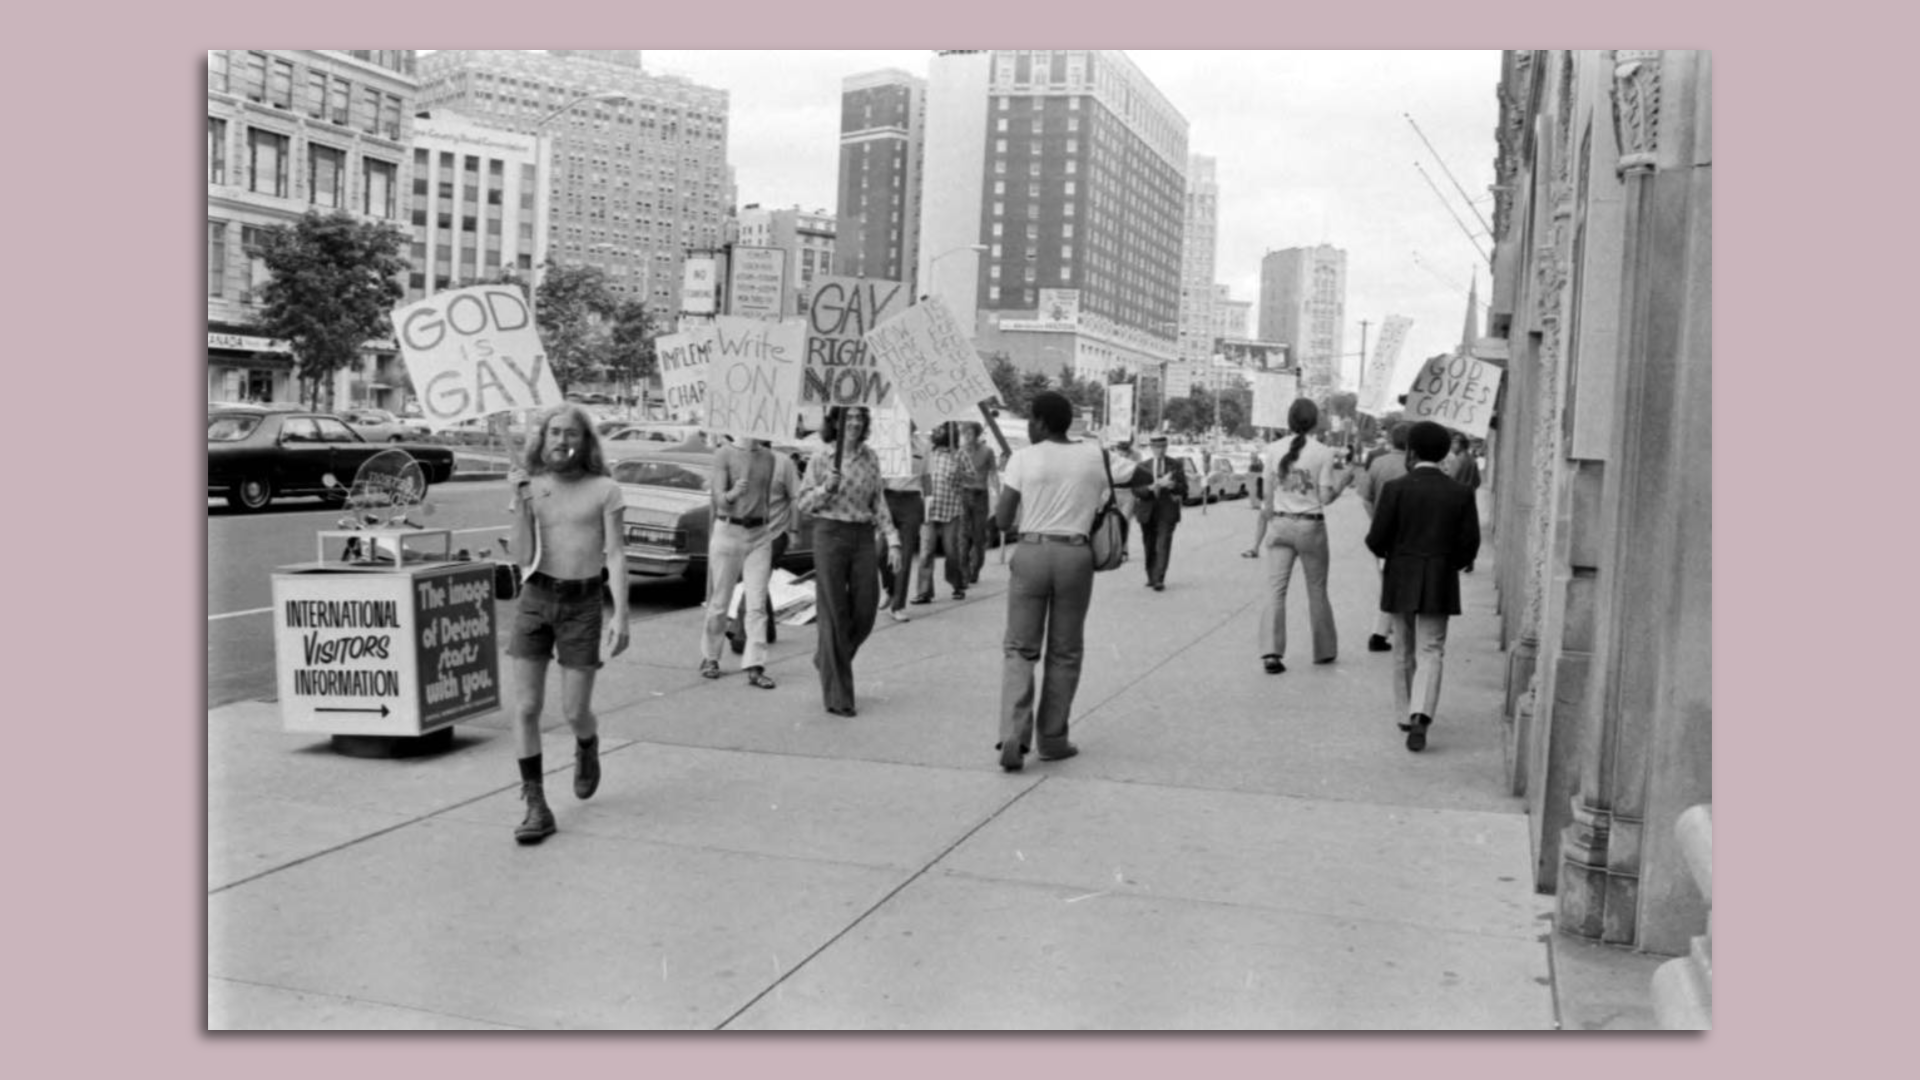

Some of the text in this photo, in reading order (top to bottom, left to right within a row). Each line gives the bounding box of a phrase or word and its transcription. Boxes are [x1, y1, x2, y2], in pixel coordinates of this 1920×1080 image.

[403, 291, 529, 351] GOD
[811, 283, 901, 337] GAY
[868, 299, 948, 355] NOW IS
[460, 338, 495, 361] IS
[717, 327, 793, 363] Write
[807, 336, 877, 367] RIGH
[879, 336, 918, 372] TIME
[726, 362, 778, 397] ON
[892, 351, 928, 380] GAY
[899, 361, 943, 391] COME
[1429, 356, 1483, 380] GOD
[425, 354, 544, 419] GAY
[803, 366, 891, 405] NOW
[910, 361, 971, 408] AID OF
[1413, 376, 1491, 404] LOVES
[707, 390, 792, 437] BRIAN
[1417, 395, 1477, 424] GAYS
[418, 576, 491, 610] The image
[286, 600, 400, 628] INTERNATIONAL
[422, 609, 490, 649] of Detroit
[438, 642, 479, 672] starts
[295, 669, 399, 696] INFORMATION
[425, 669, 493, 705] with you.
